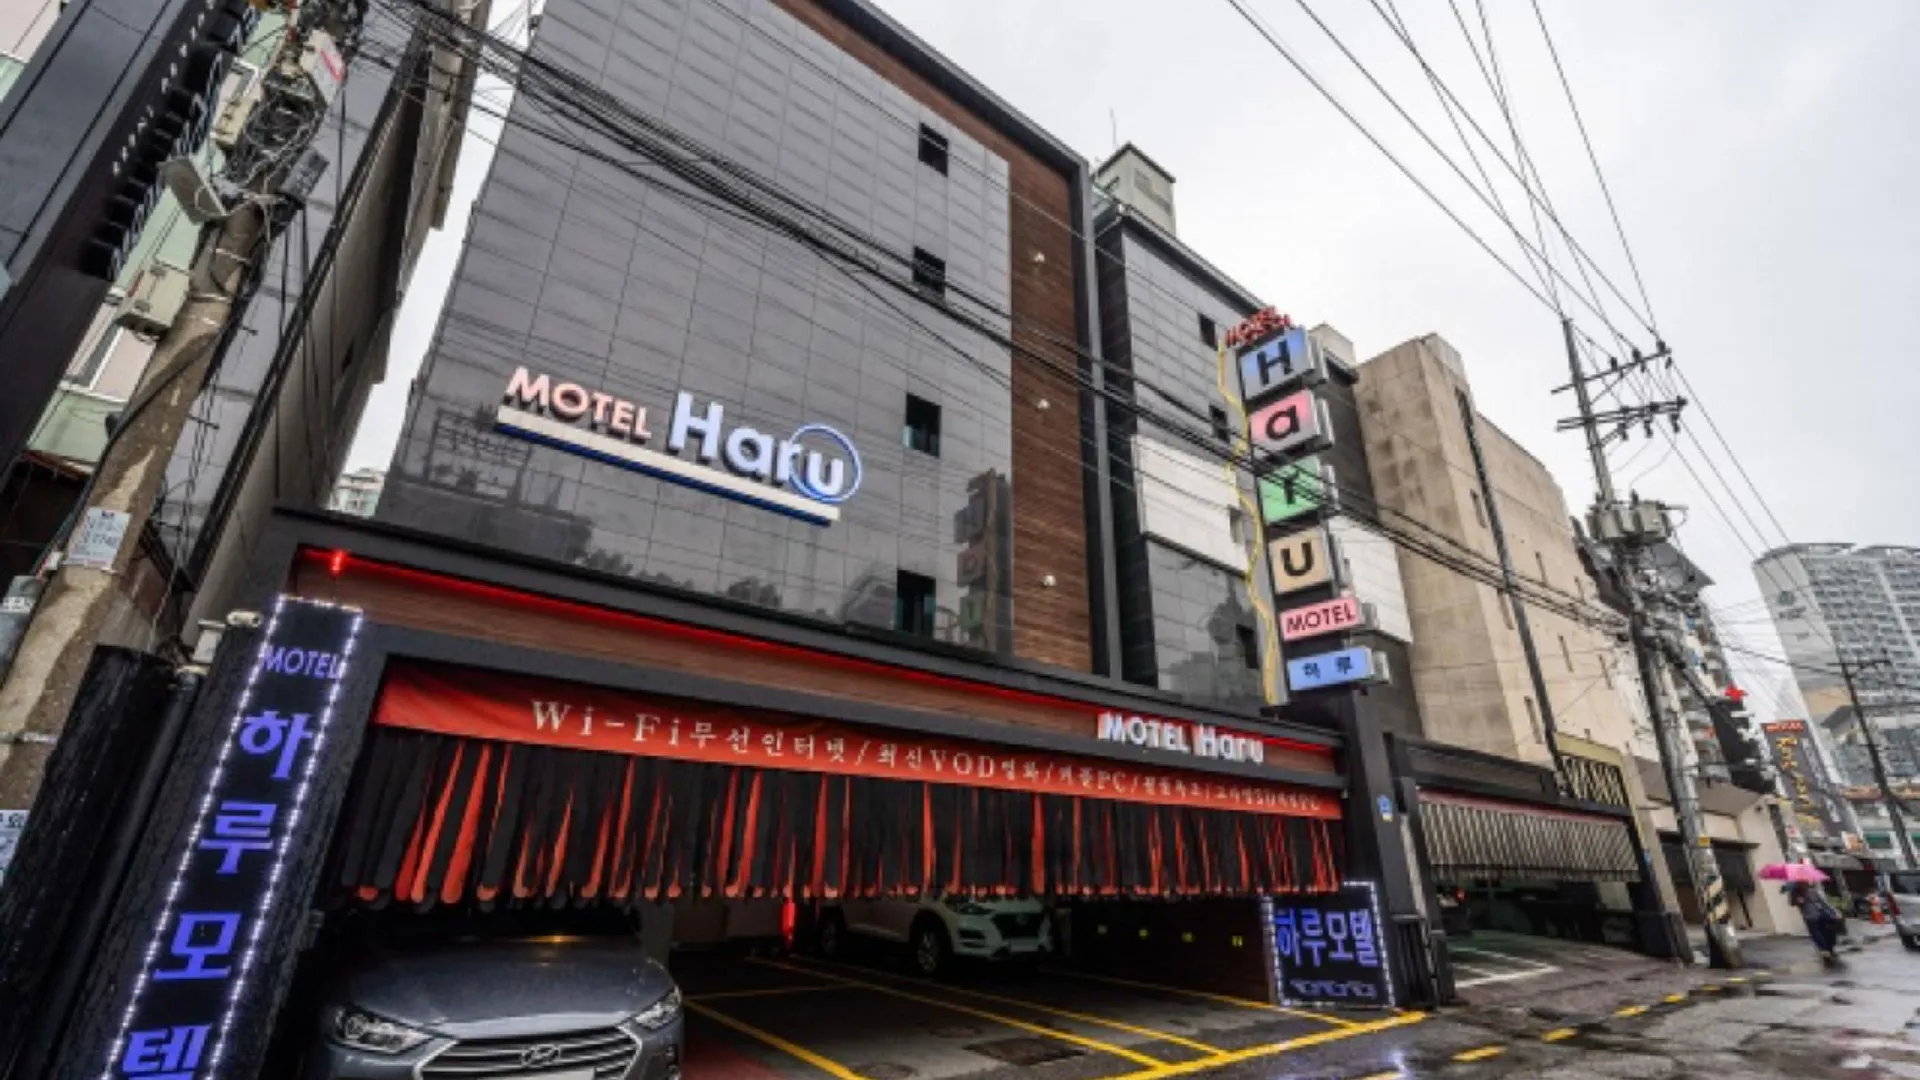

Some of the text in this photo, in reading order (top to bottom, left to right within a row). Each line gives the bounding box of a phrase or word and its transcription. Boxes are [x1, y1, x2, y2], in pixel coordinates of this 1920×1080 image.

[505, 366, 845, 496] MOTEL Haru
[1286, 602, 1357, 634] MOTEL
[262, 645, 341, 679] MOTEL
[1097, 711, 1264, 766] MOTEL Haru
